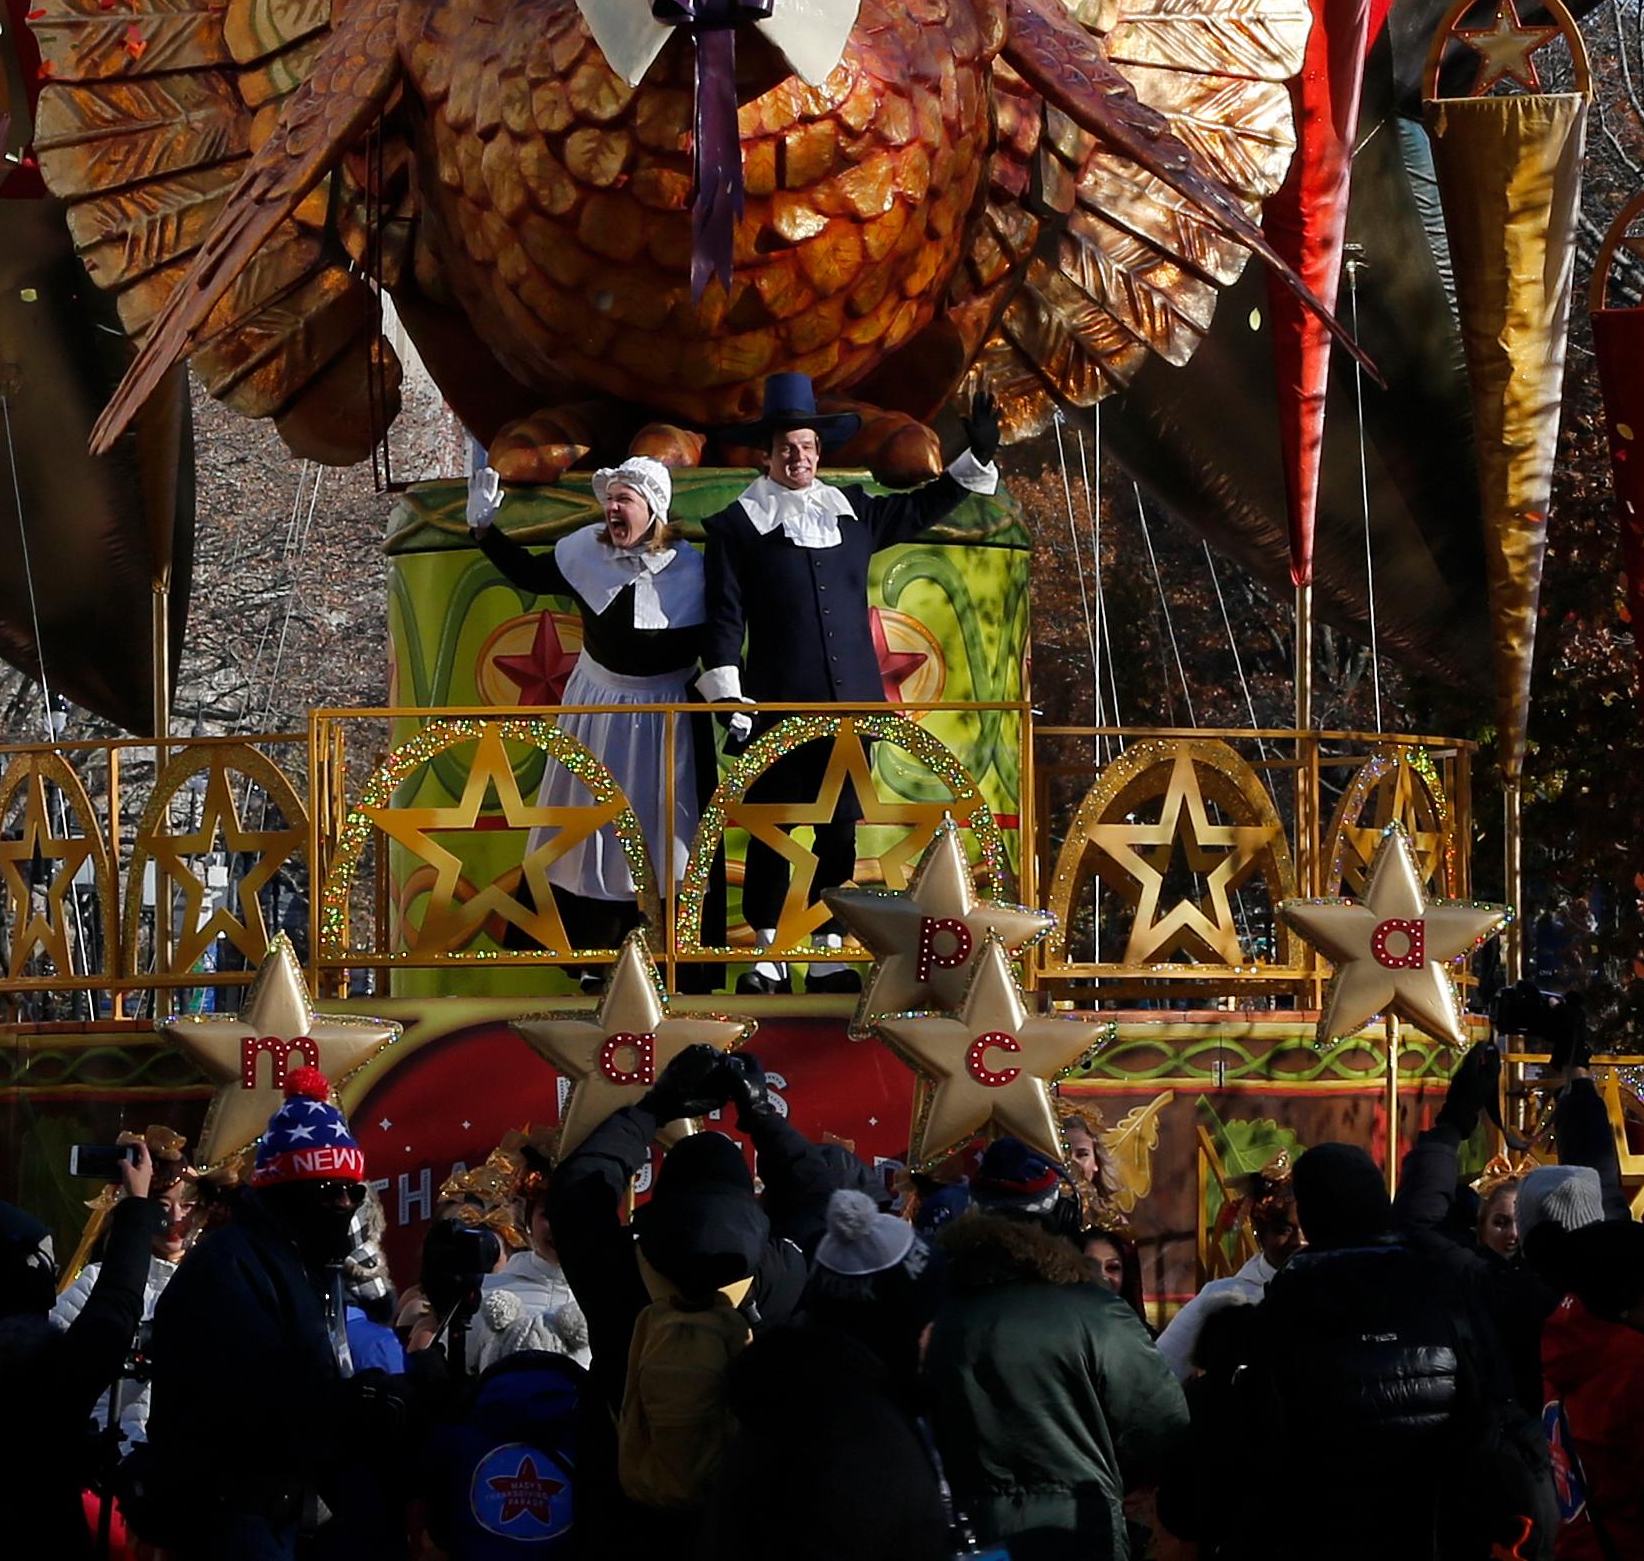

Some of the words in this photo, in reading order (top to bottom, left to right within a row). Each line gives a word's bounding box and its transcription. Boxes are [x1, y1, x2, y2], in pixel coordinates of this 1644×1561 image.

[917, 917, 972, 983] p
[1370, 918, 1425, 970] a
[241, 1036, 320, 1090] m
[598, 1032, 655, 1086] a
[967, 1031, 1021, 1087] c
